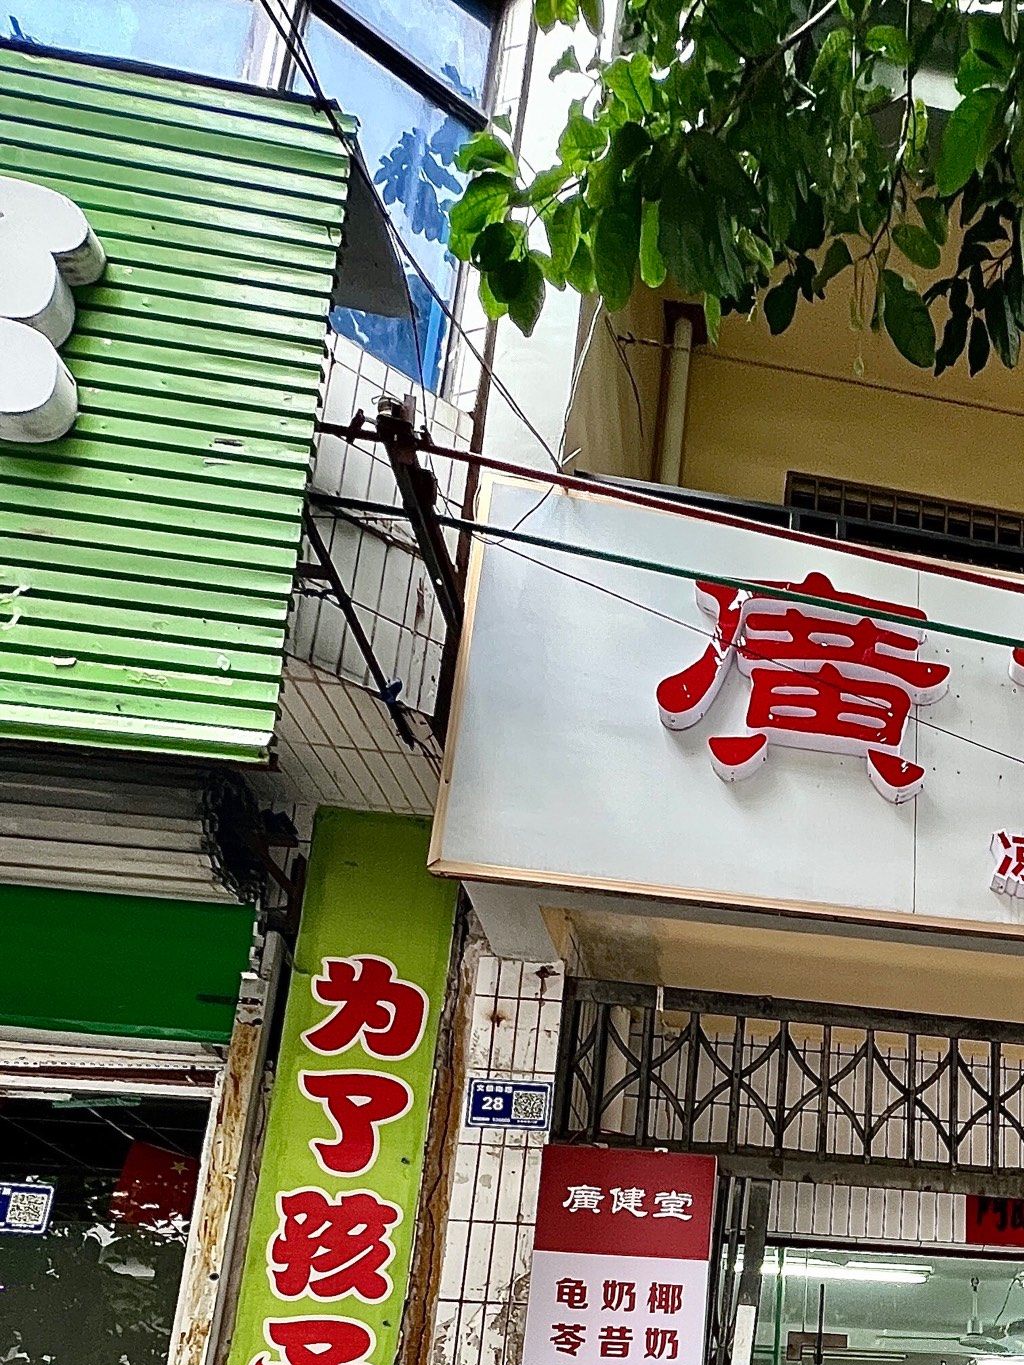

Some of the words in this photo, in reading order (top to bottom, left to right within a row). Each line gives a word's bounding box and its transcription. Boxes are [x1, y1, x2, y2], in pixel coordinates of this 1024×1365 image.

[481, 1096, 504, 1111] 28
[562, 1184, 693, 1221] 廣健堂
